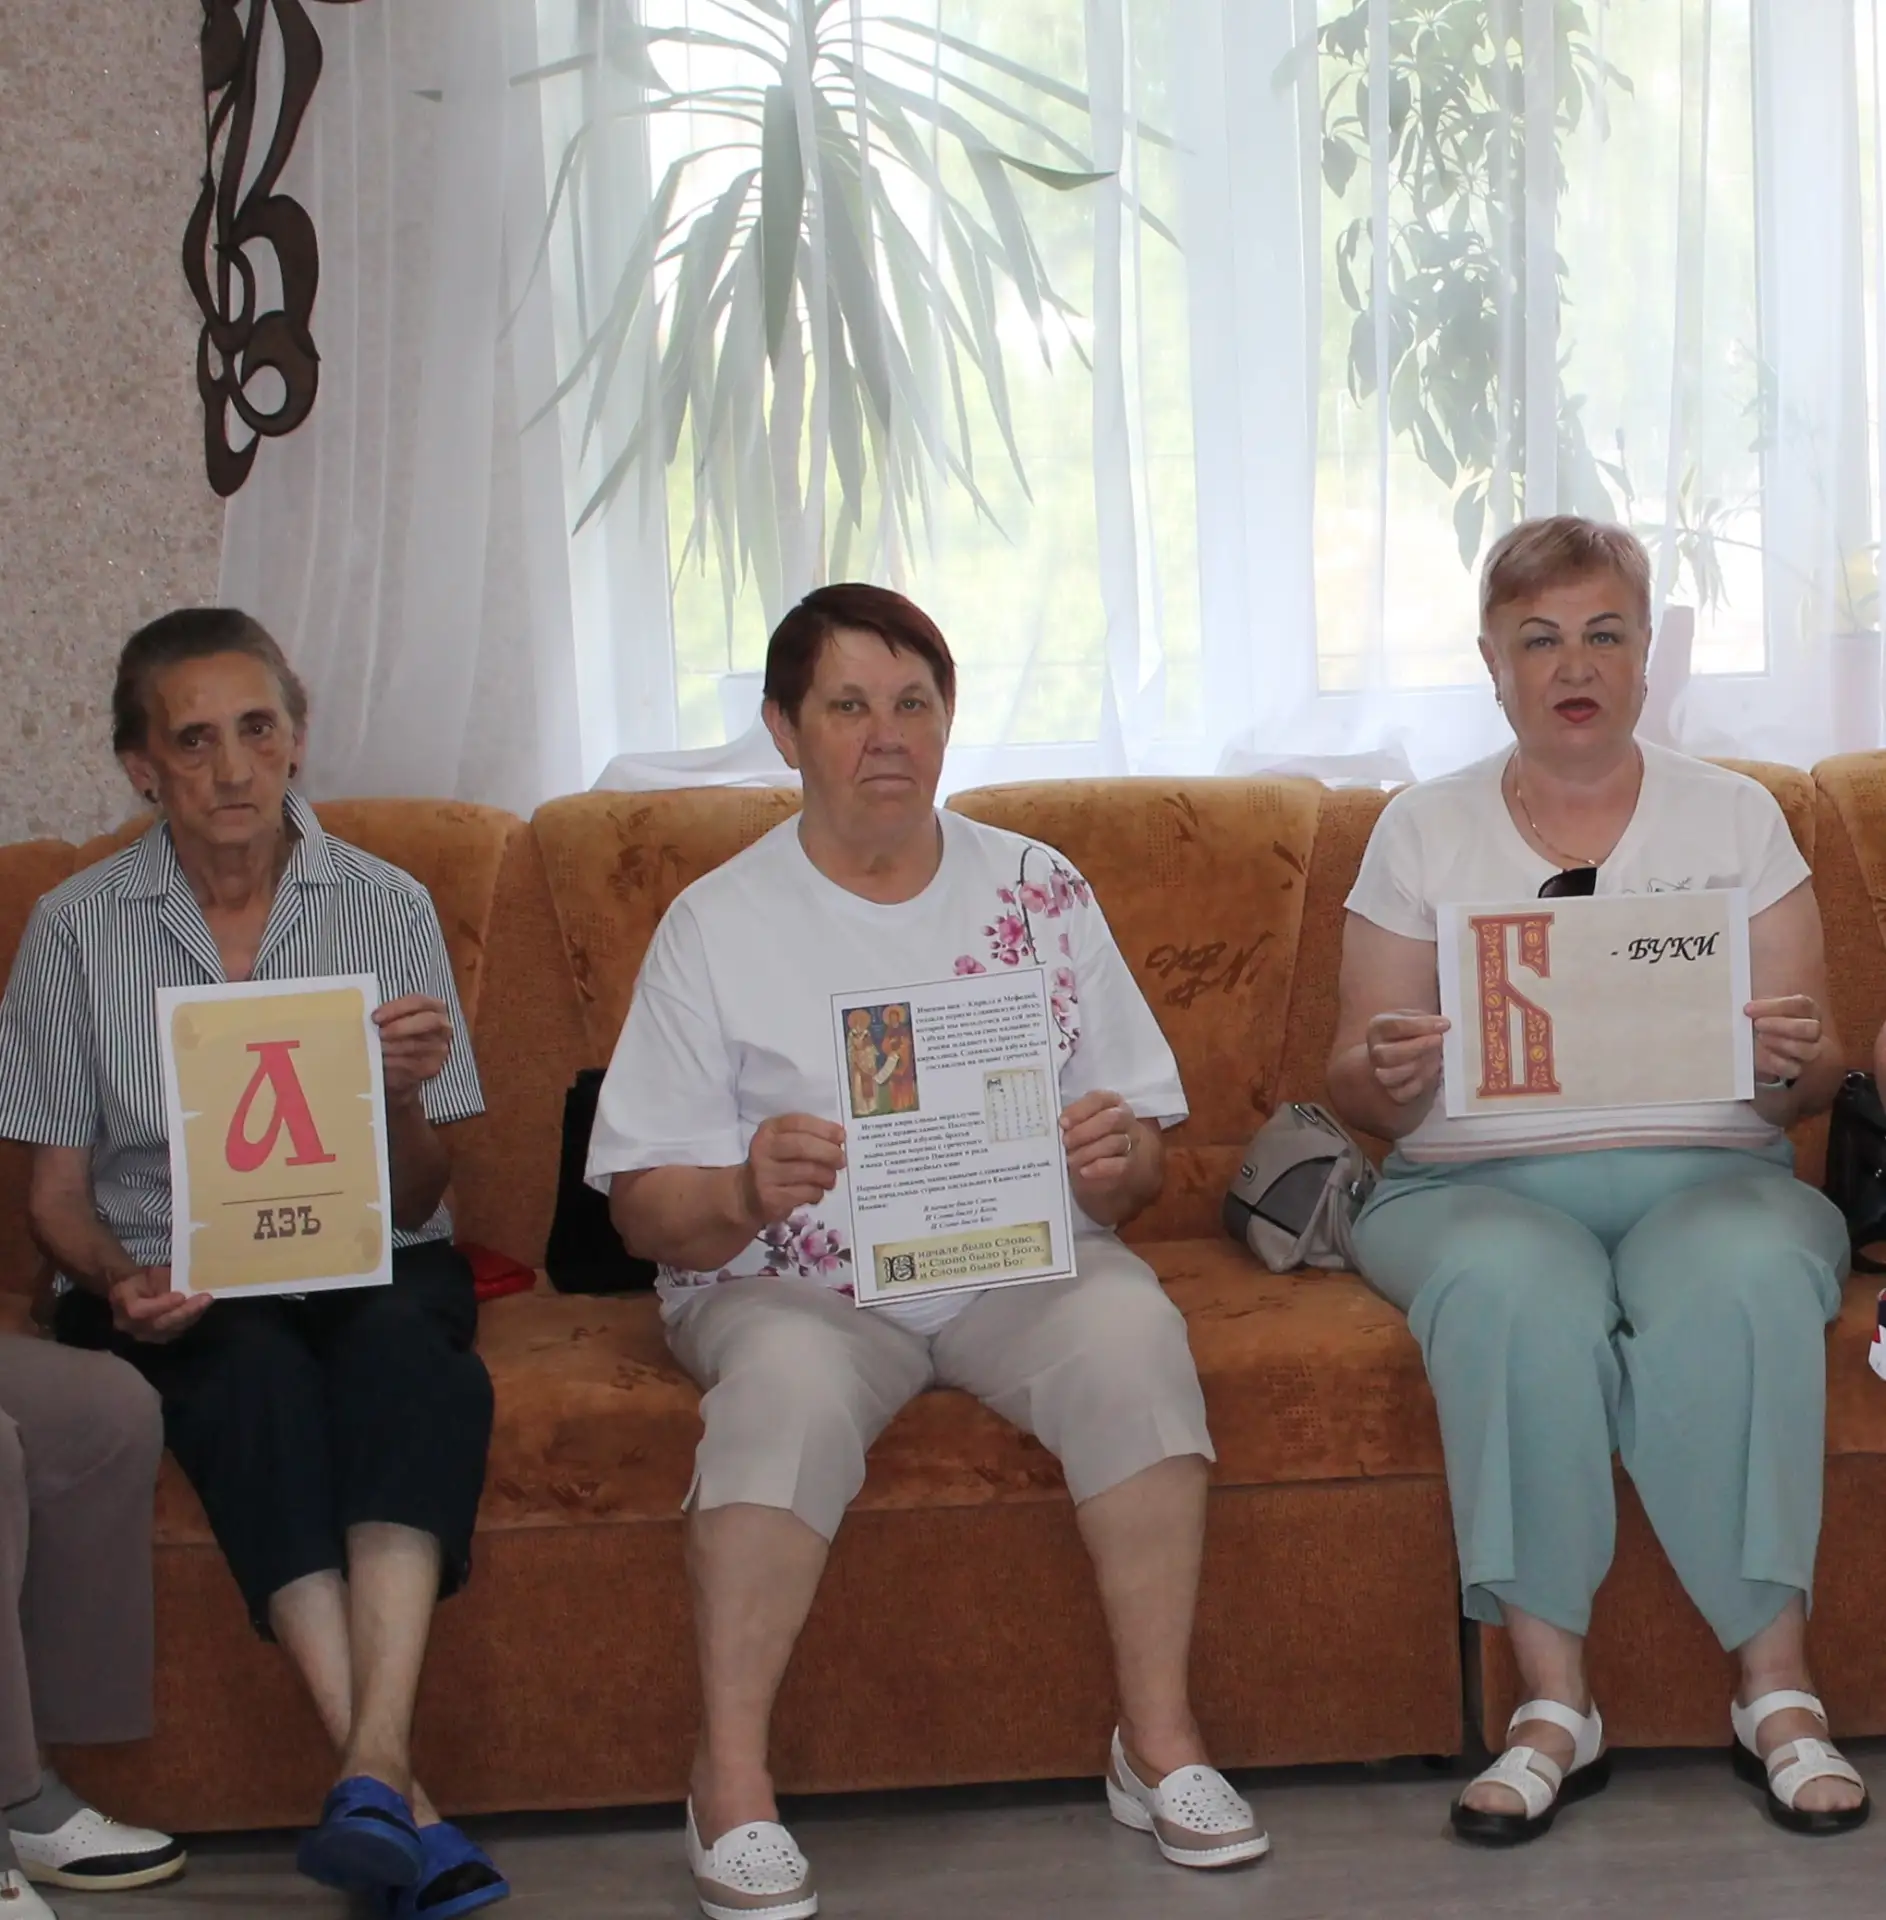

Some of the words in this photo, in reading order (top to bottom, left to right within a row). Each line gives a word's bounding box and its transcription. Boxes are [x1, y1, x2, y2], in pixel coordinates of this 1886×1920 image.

[1628, 932, 1720, 964] БУКИ
[1469, 911, 1562, 1099] Б
[253, 1205, 322, 1240] АЗЪ
[917, 1246, 958, 1259] начале
[961, 1239, 992, 1252] было
[929, 1254, 966, 1267] Слово
[968, 1248, 999, 1261] было
[1002, 1249, 1007, 1258] у
[929, 1264, 967, 1277] Слово
[969, 1259, 1000, 1272] было
